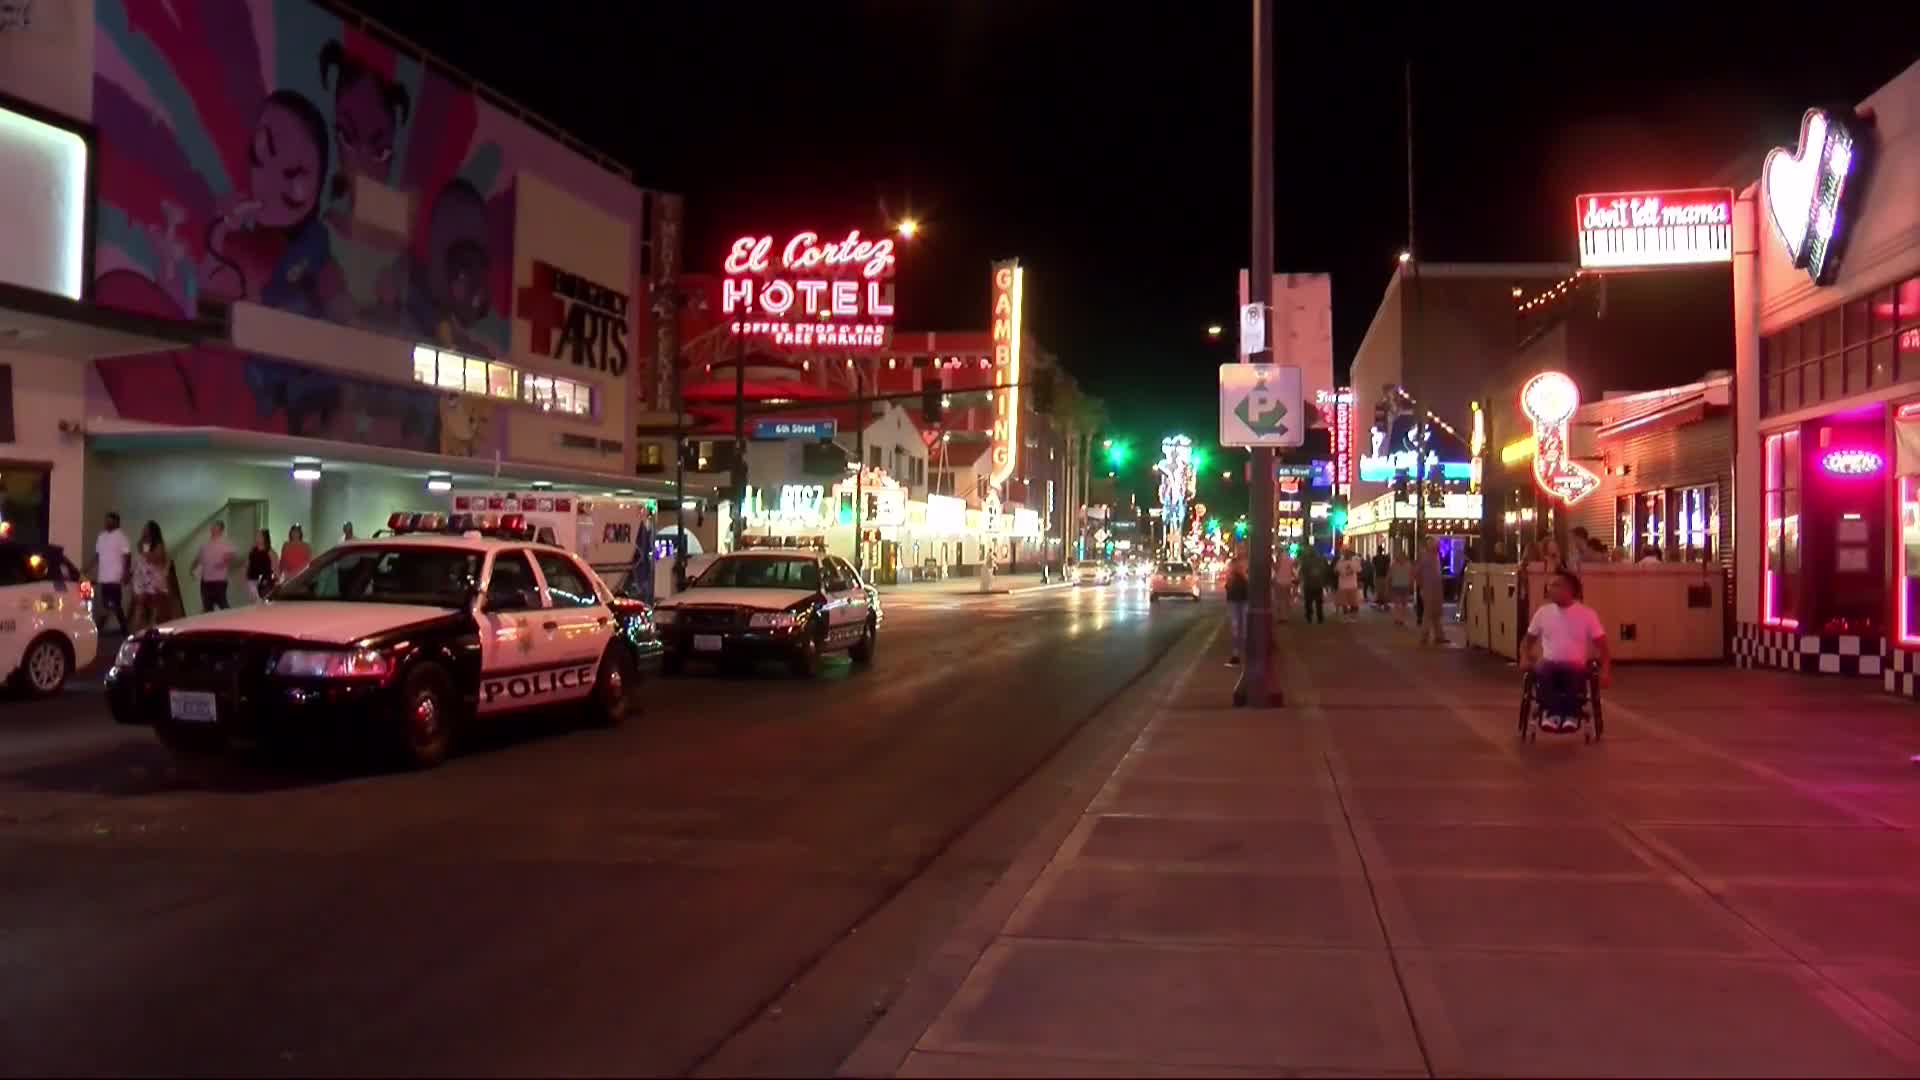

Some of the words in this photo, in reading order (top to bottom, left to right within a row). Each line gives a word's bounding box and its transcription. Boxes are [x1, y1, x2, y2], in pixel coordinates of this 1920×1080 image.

[1583, 197, 1629, 229] don't
[1630, 197, 1662, 227] tell
[1662, 202, 1728, 225] mama
[724, 235, 774, 274] El
[782, 230, 896, 278] Cortez
[722, 278, 895, 316] HOTEL
[554, 303, 629, 377] ARTS
[731, 322, 790, 334] COFFEE
[795, 323, 836, 334] SHOP
[855, 324, 885, 335] BAR
[775, 332, 812, 345] FREE
[818, 333, 883, 346] PARKING
[775, 424, 790, 433] 6th
[792, 424, 816, 433] Street
[1829, 453, 1876, 473] OPEN
[484, 666, 592, 703] POLICE
